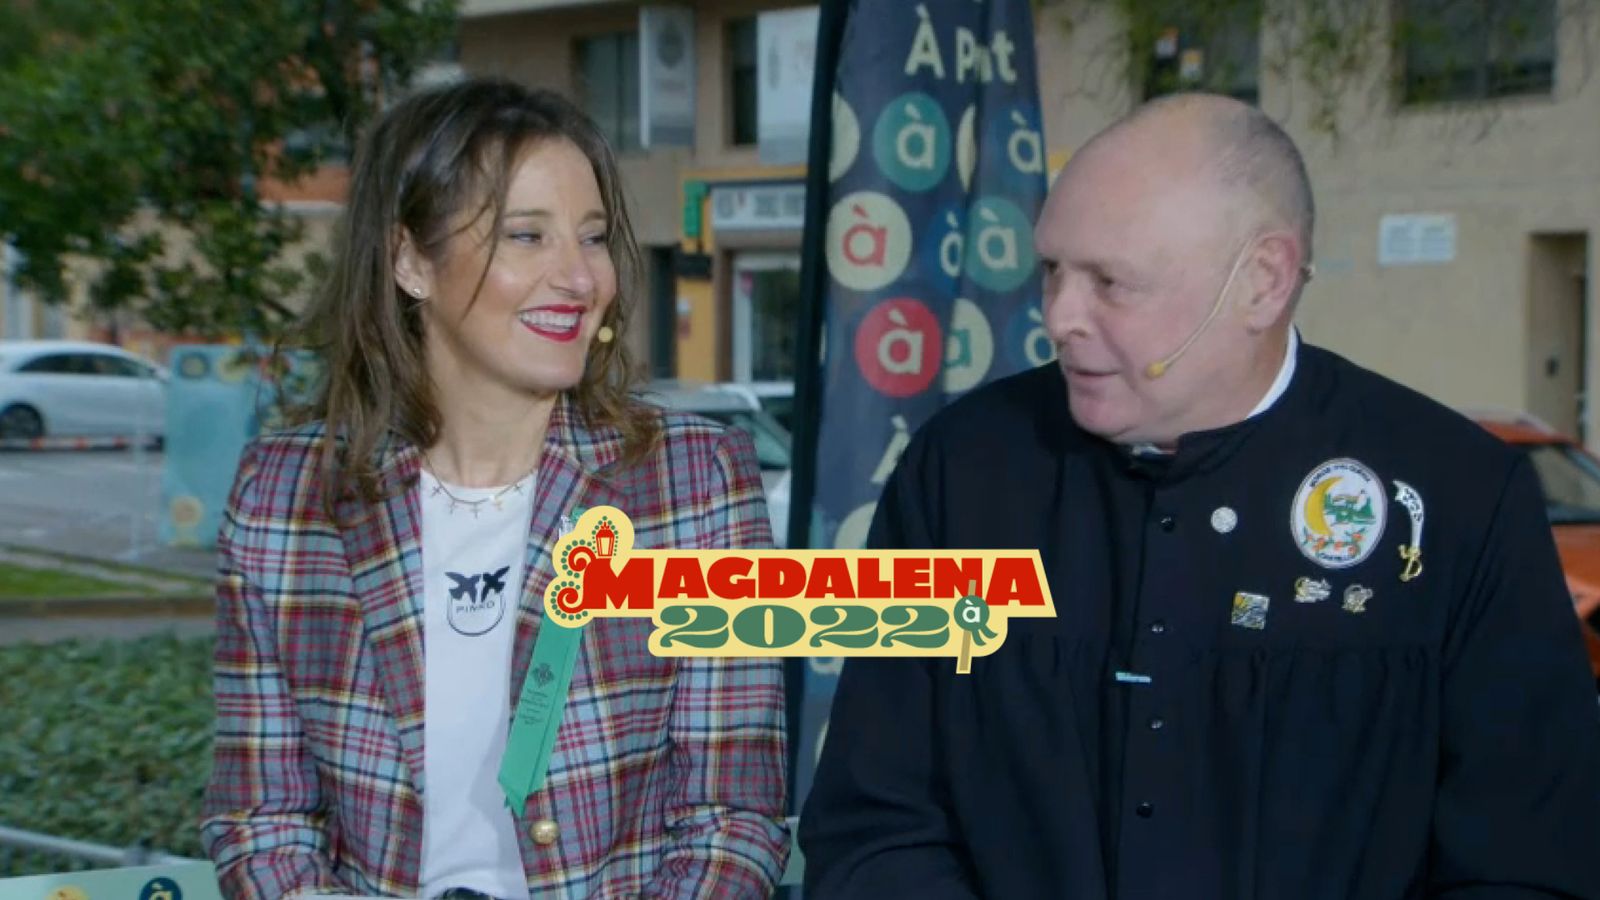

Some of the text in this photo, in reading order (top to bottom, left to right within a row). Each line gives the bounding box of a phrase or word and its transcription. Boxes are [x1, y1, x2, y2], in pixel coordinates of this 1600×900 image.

[904, 4, 946, 79] À
[896, 103, 936, 169] à
[1008, 109, 1043, 173] à
[842, 204, 887, 267] à
[977, 207, 1019, 270] à
[876, 308, 924, 375] à
